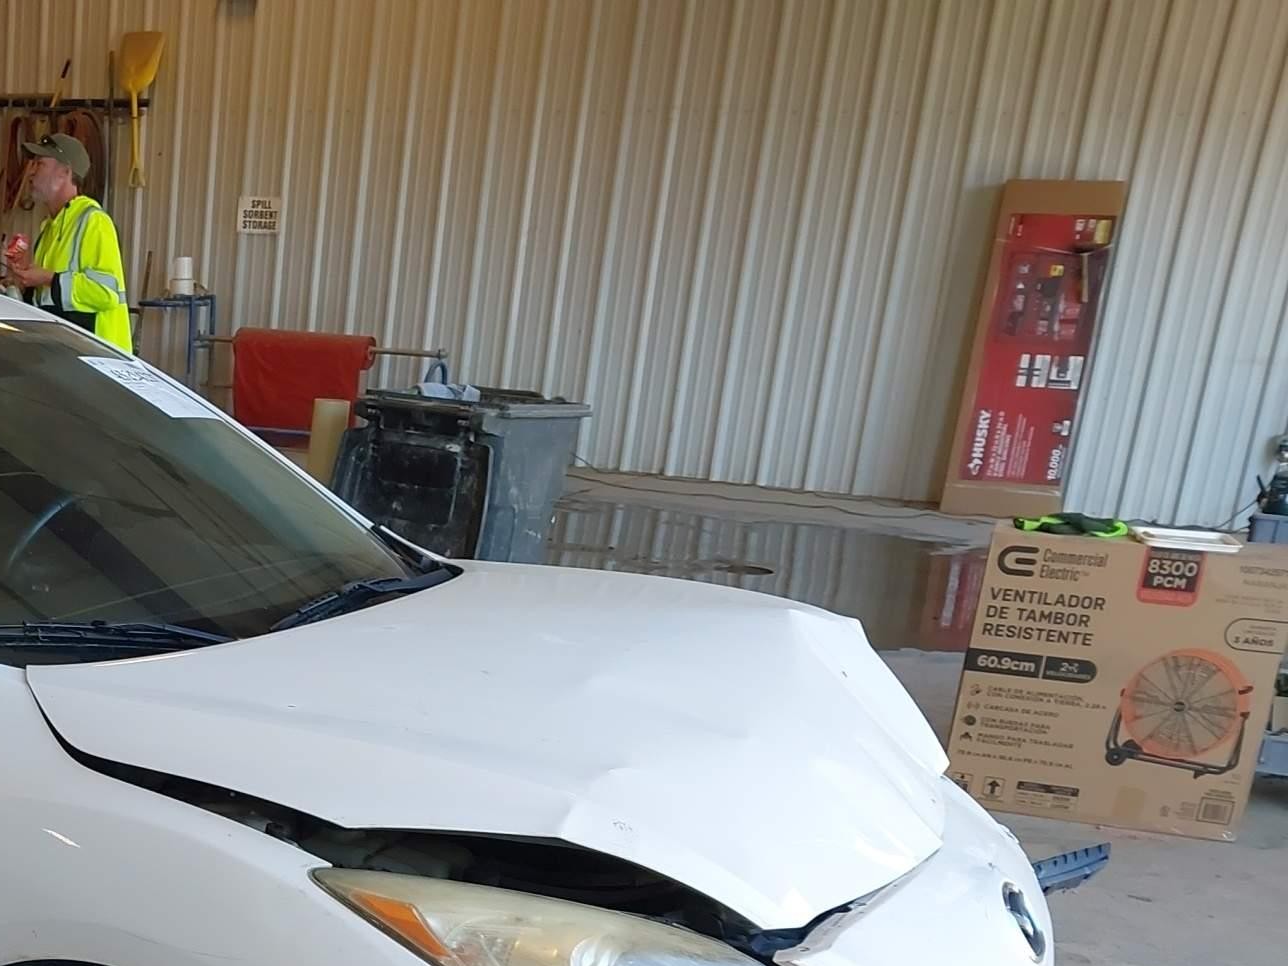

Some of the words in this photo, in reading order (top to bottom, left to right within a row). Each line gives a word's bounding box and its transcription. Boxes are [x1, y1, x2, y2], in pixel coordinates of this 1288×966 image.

[251, 199, 272, 209] SPILL
[242, 209, 279, 220] SORBENT
[242, 219, 277, 230] STORAGE
[972, 409, 992, 458] HUSKY
[1043, 548, 1109, 568] Commercial
[1148, 559, 1198, 577] 8300
[1153, 576, 1187, 589] PCM
[991, 587, 1106, 611] VENTILADOR
[985, 604, 1010, 620] DE
[1016, 607, 1091, 628] TAMBOR
[982, 622, 1094, 646] RESISTENTE
[976, 654, 1035, 673] 60.9cm
